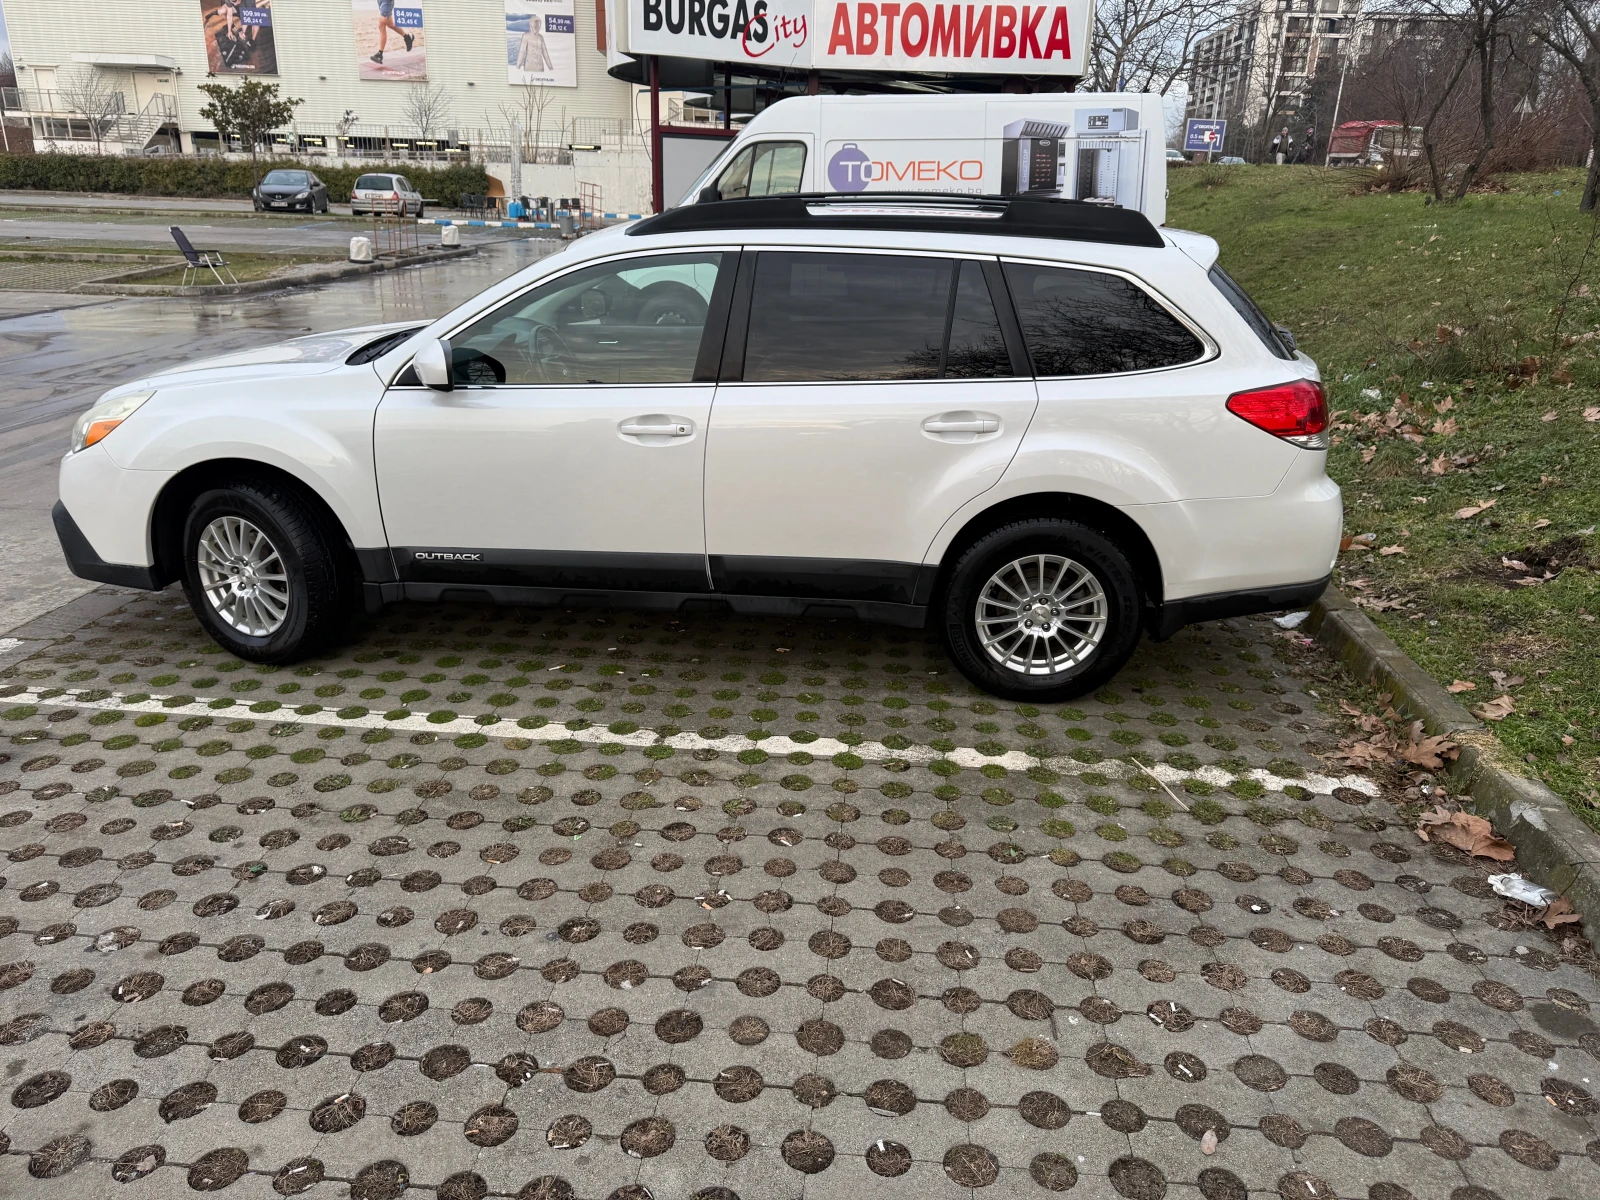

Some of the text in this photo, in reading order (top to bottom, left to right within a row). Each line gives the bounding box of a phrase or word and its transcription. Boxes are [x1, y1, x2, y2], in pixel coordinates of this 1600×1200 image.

[643, 0, 768, 43] BURGAS
[742, 14, 807, 57] City
[827, 2, 1072, 60] АВТОМИВКА
[839, 160, 983, 182] TOMEKO
[415, 552, 481, 561] OUTBACK
